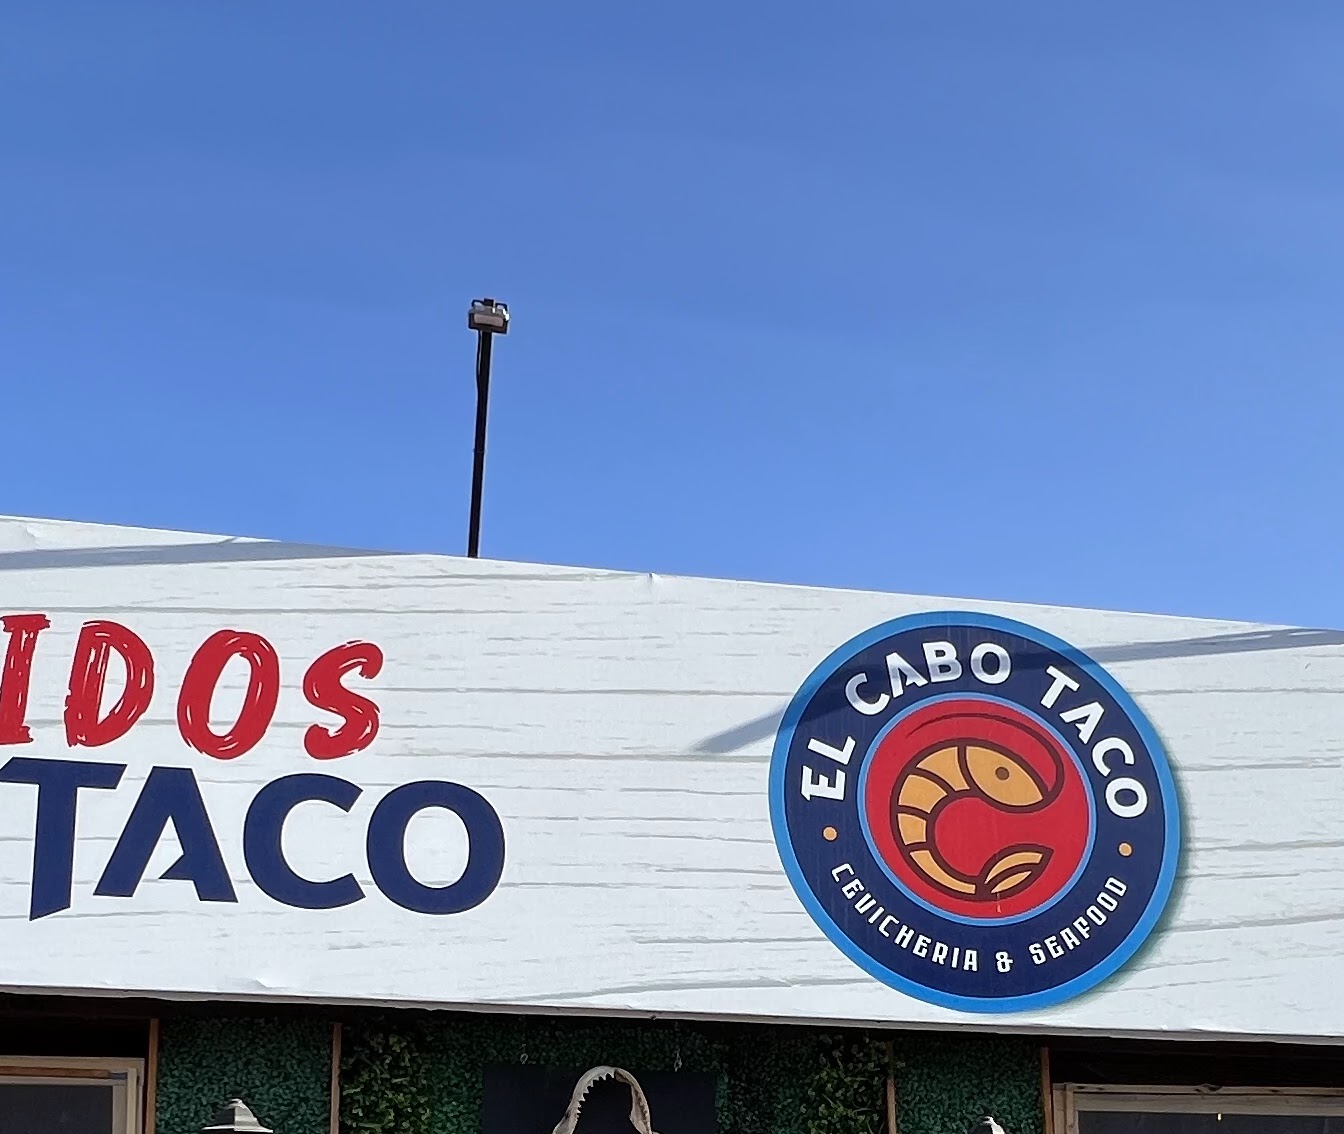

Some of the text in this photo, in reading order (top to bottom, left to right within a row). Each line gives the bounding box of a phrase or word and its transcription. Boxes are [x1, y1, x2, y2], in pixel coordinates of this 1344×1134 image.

[800, 640, 1149, 819] EL CABO TACO
[996, 951, 1014, 973] &
[1029, 876, 1128, 966] SEAFOOD
